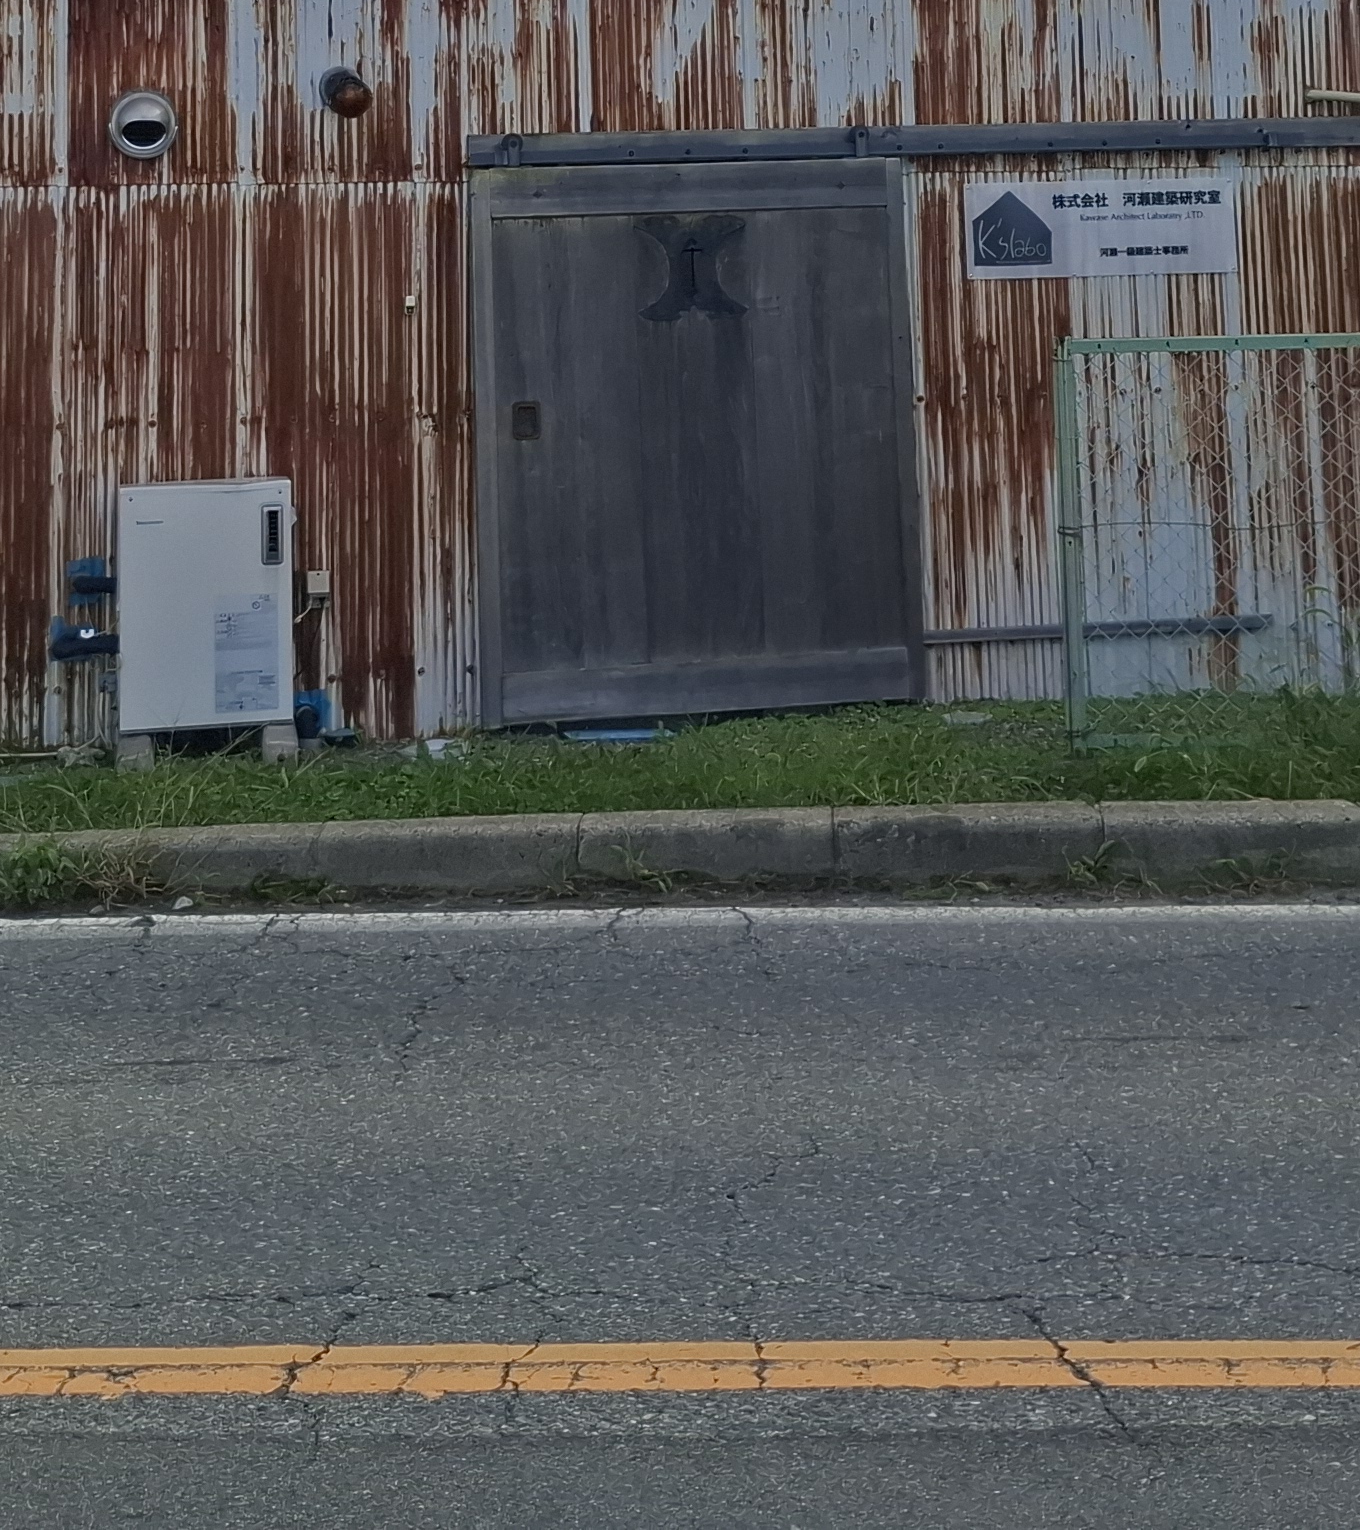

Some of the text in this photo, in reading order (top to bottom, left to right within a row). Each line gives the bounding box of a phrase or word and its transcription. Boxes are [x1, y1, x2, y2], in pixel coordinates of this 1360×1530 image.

[1052, 192, 1109, 210] 株式会社
[1110, 212, 1145, 221] Architect
